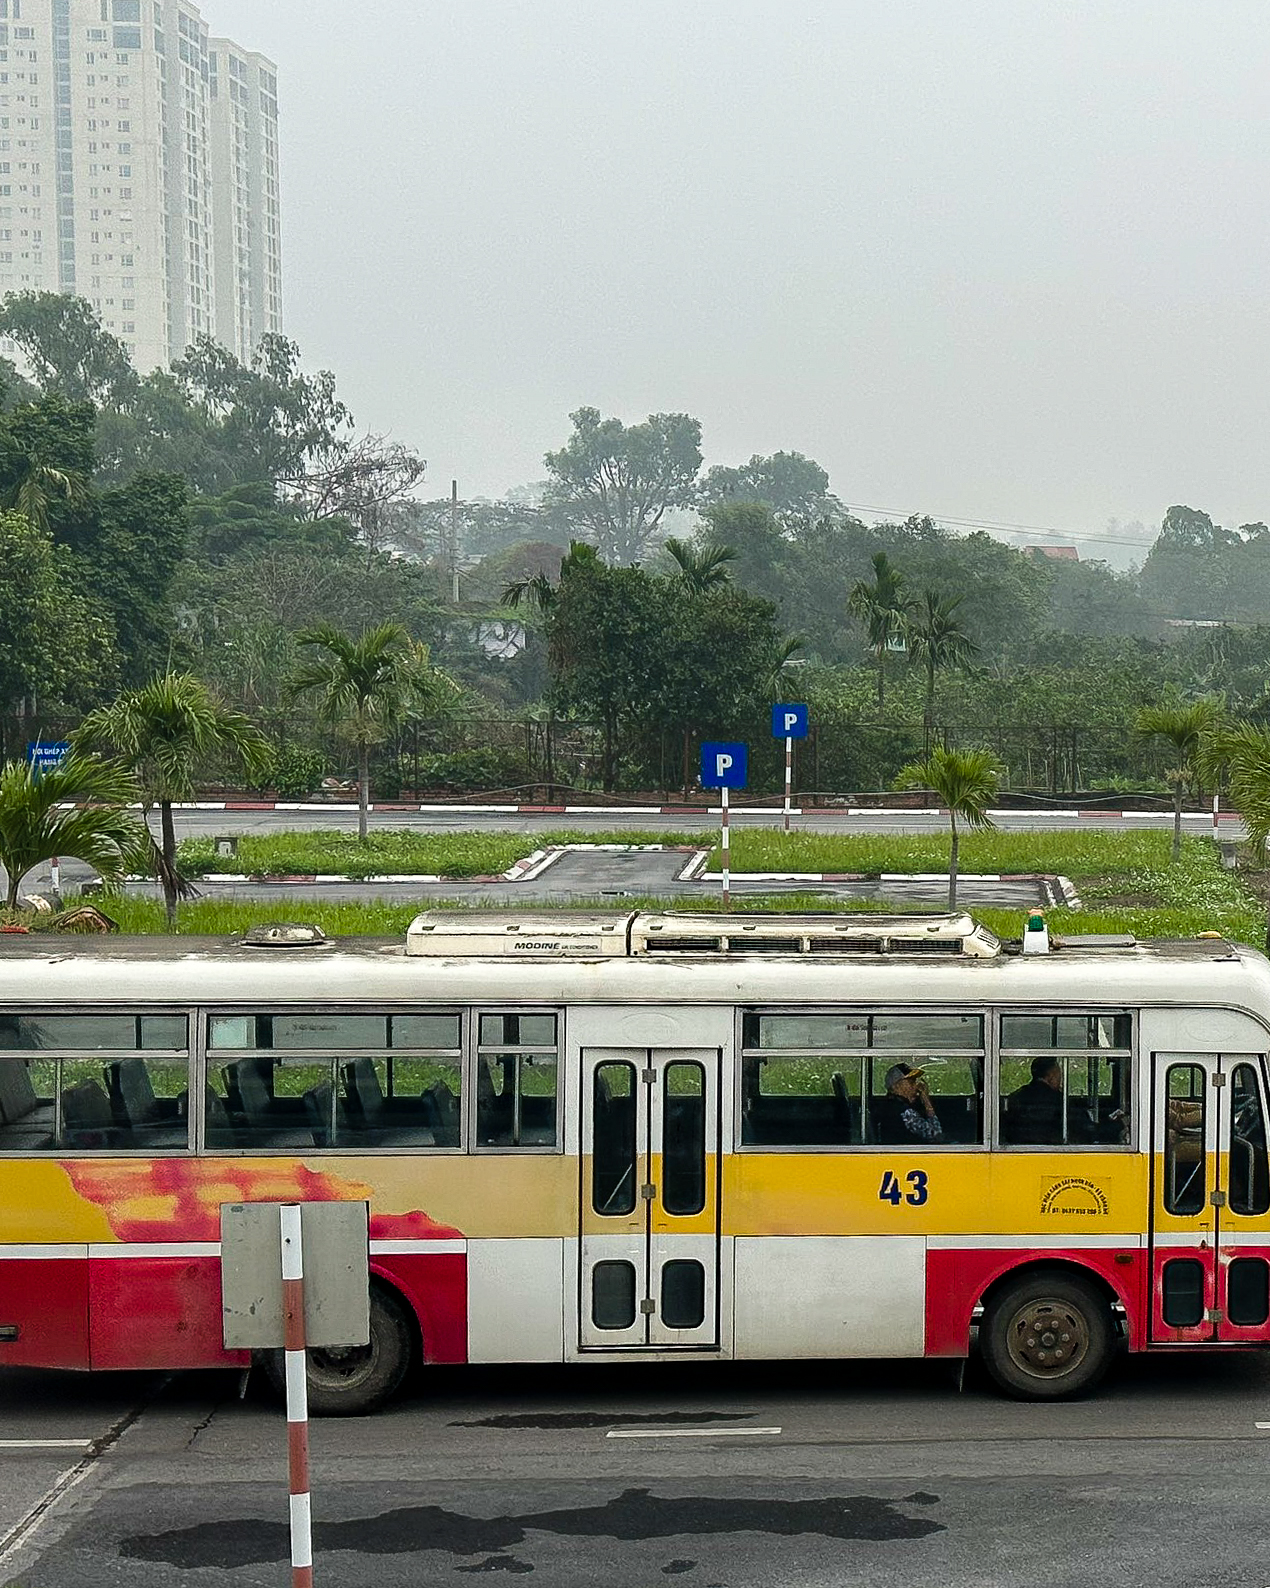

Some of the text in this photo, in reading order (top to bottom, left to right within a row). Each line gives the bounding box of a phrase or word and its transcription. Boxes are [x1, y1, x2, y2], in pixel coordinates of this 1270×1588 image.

[785, 713, 797, 730] P
[716, 753, 733, 777] P
[514, 942, 561, 950] MODINE
[879, 1170, 929, 1206] 43
